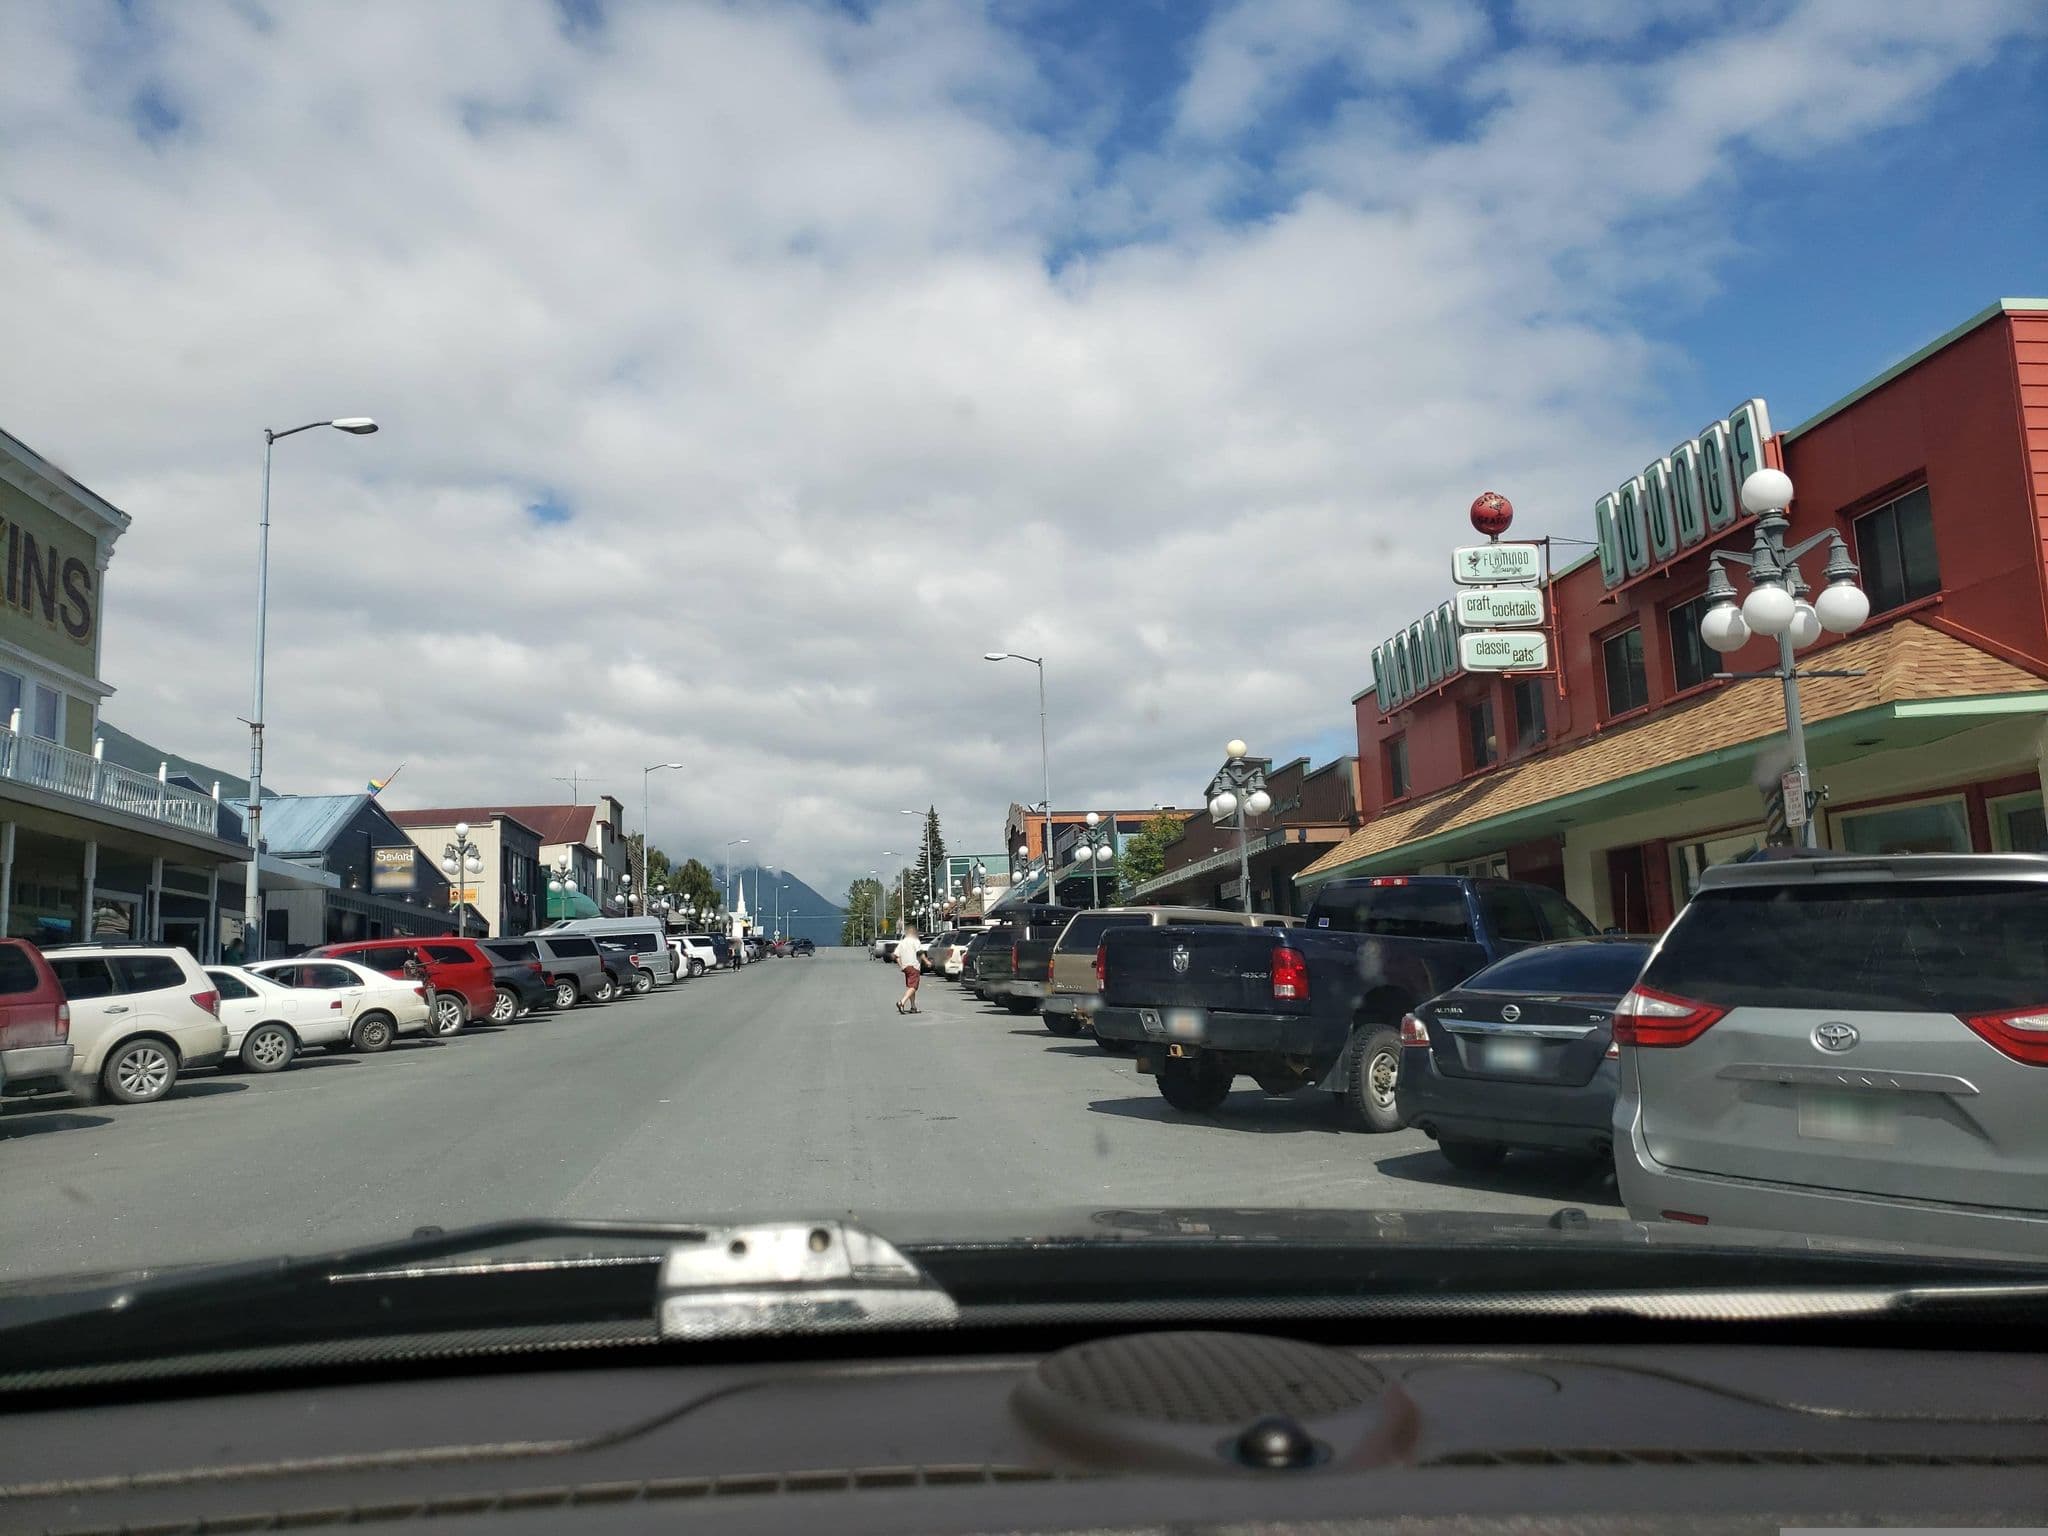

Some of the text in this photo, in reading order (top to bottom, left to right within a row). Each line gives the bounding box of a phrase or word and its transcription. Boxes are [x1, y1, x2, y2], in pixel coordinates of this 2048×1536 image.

[1483, 550, 1529, 567] FLAMINGO
[0, 515, 91, 639] INS
[1466, 595, 1537, 617] craft cocktails
[1475, 639, 1535, 662] classic eats
